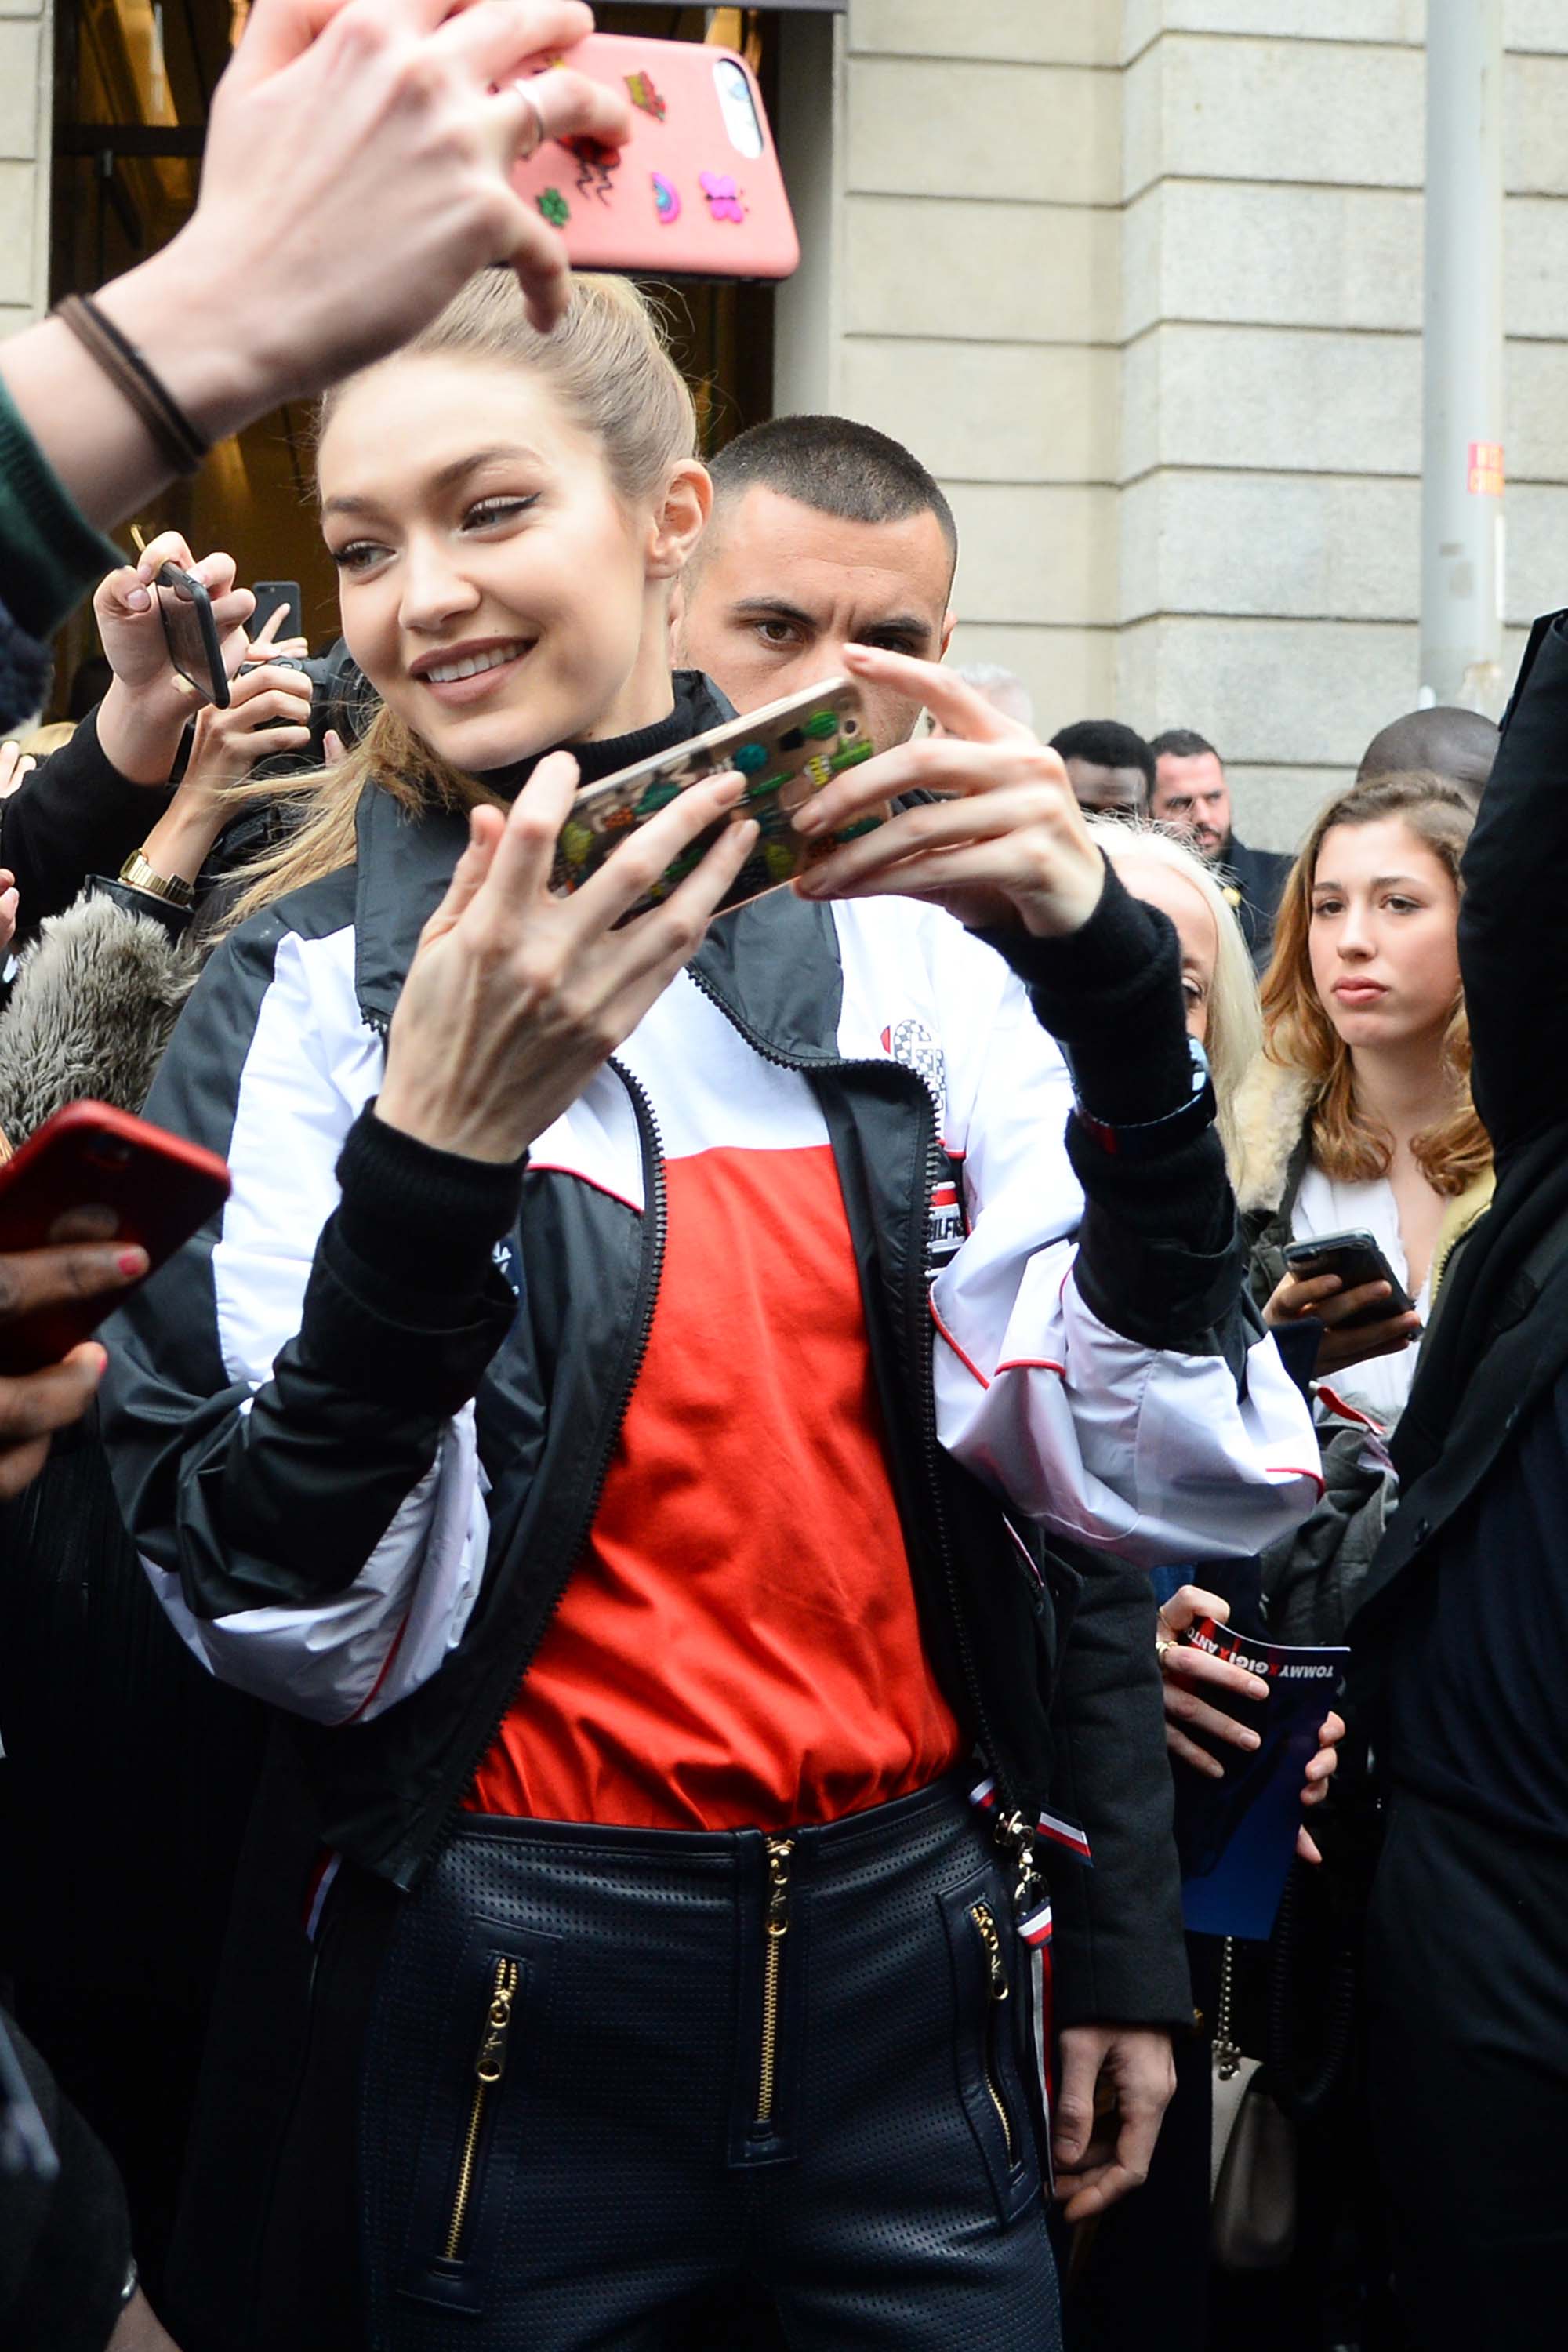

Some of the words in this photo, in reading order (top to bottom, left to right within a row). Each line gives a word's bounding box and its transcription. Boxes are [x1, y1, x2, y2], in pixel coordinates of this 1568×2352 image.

[1186, 1627, 1218, 1654] ANTO
[1229, 1651, 1269, 1675] GIGI
[1279, 1664, 1334, 1678] TOMMY
